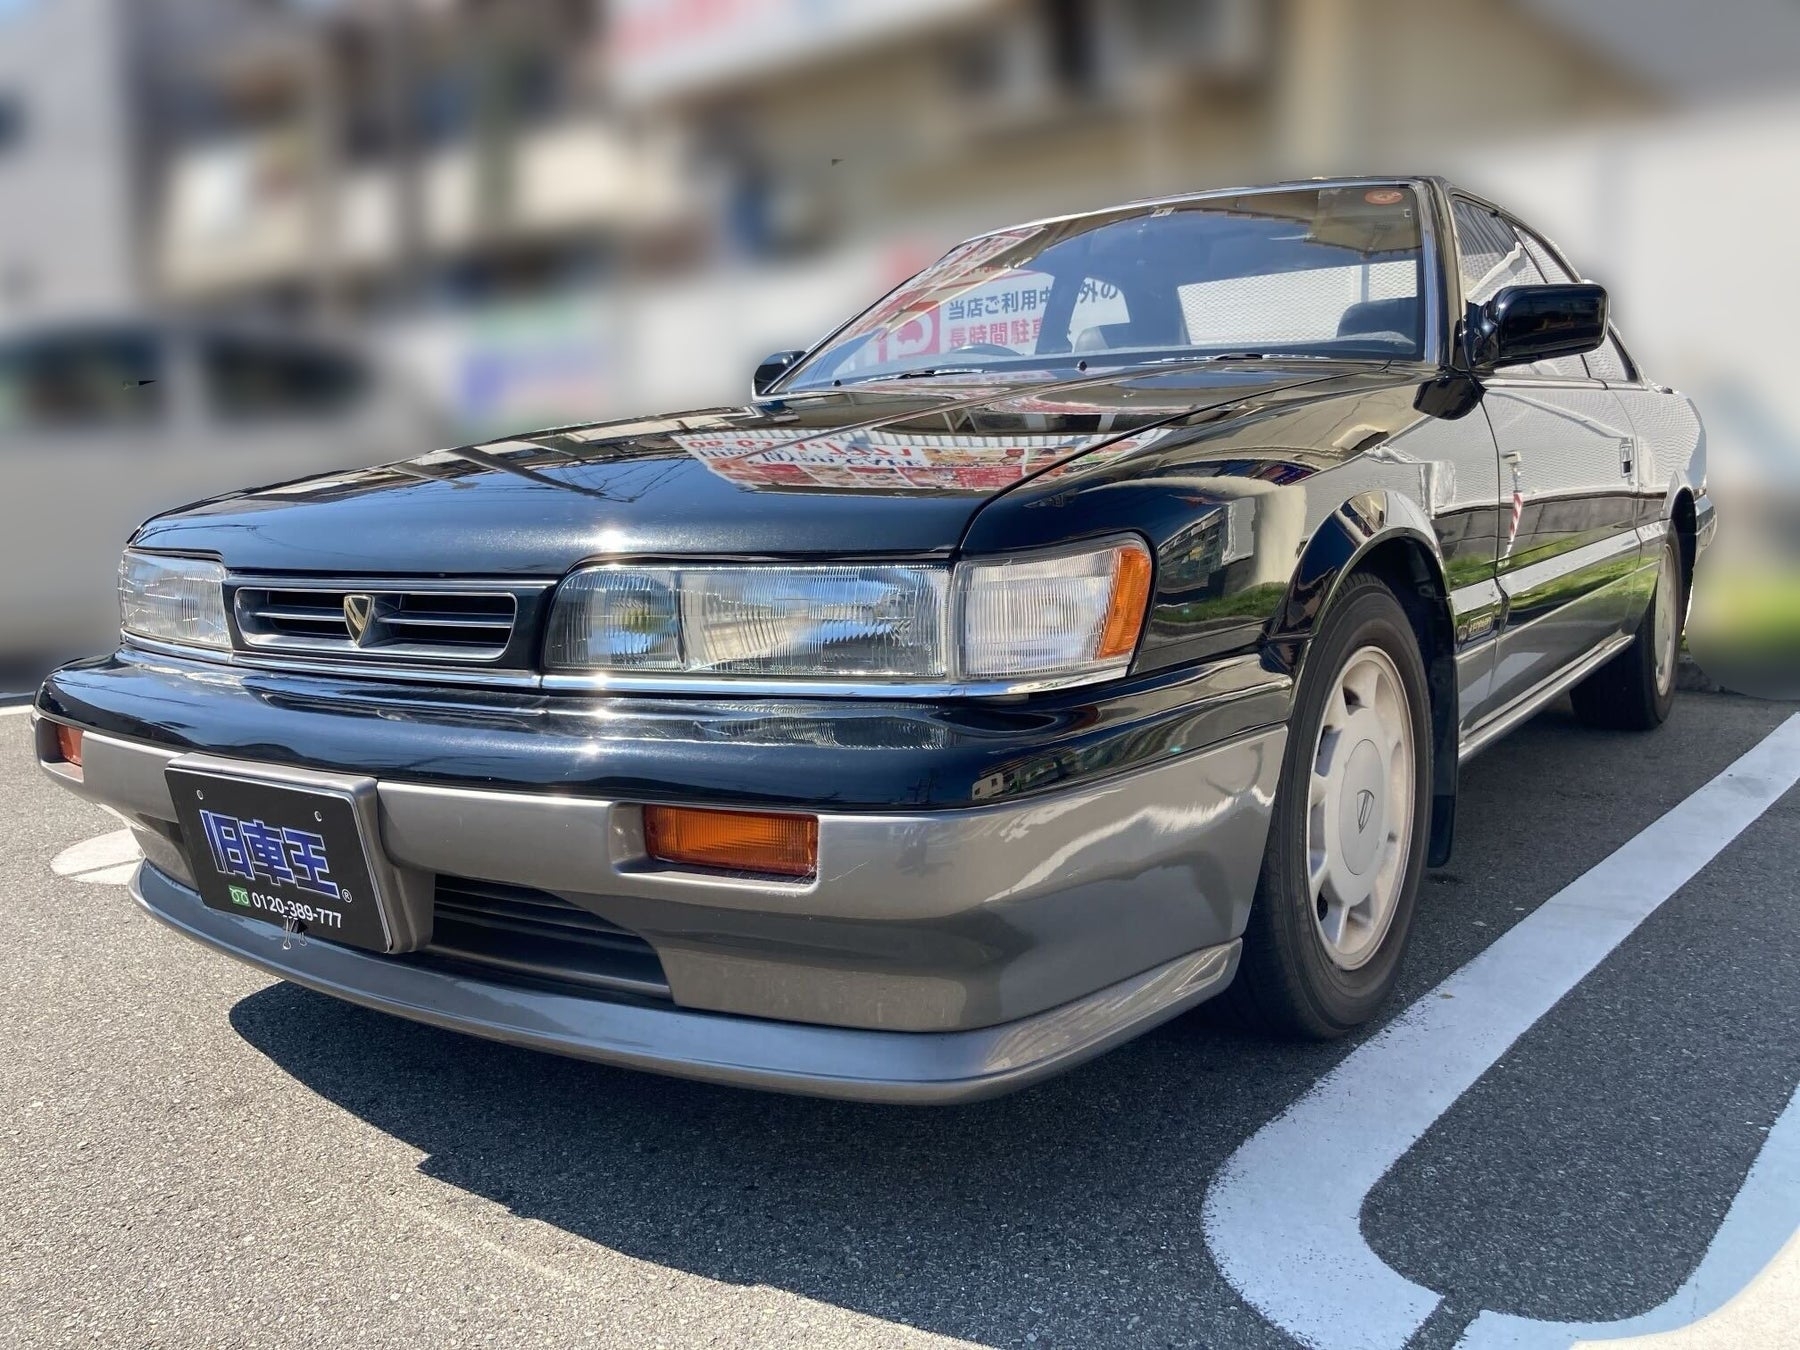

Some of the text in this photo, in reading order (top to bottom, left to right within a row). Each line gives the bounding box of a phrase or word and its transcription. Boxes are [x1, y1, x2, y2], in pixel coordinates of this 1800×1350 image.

[199, 809, 341, 899] 旧車王
[252, 892, 342, 928] 0120-389-777
